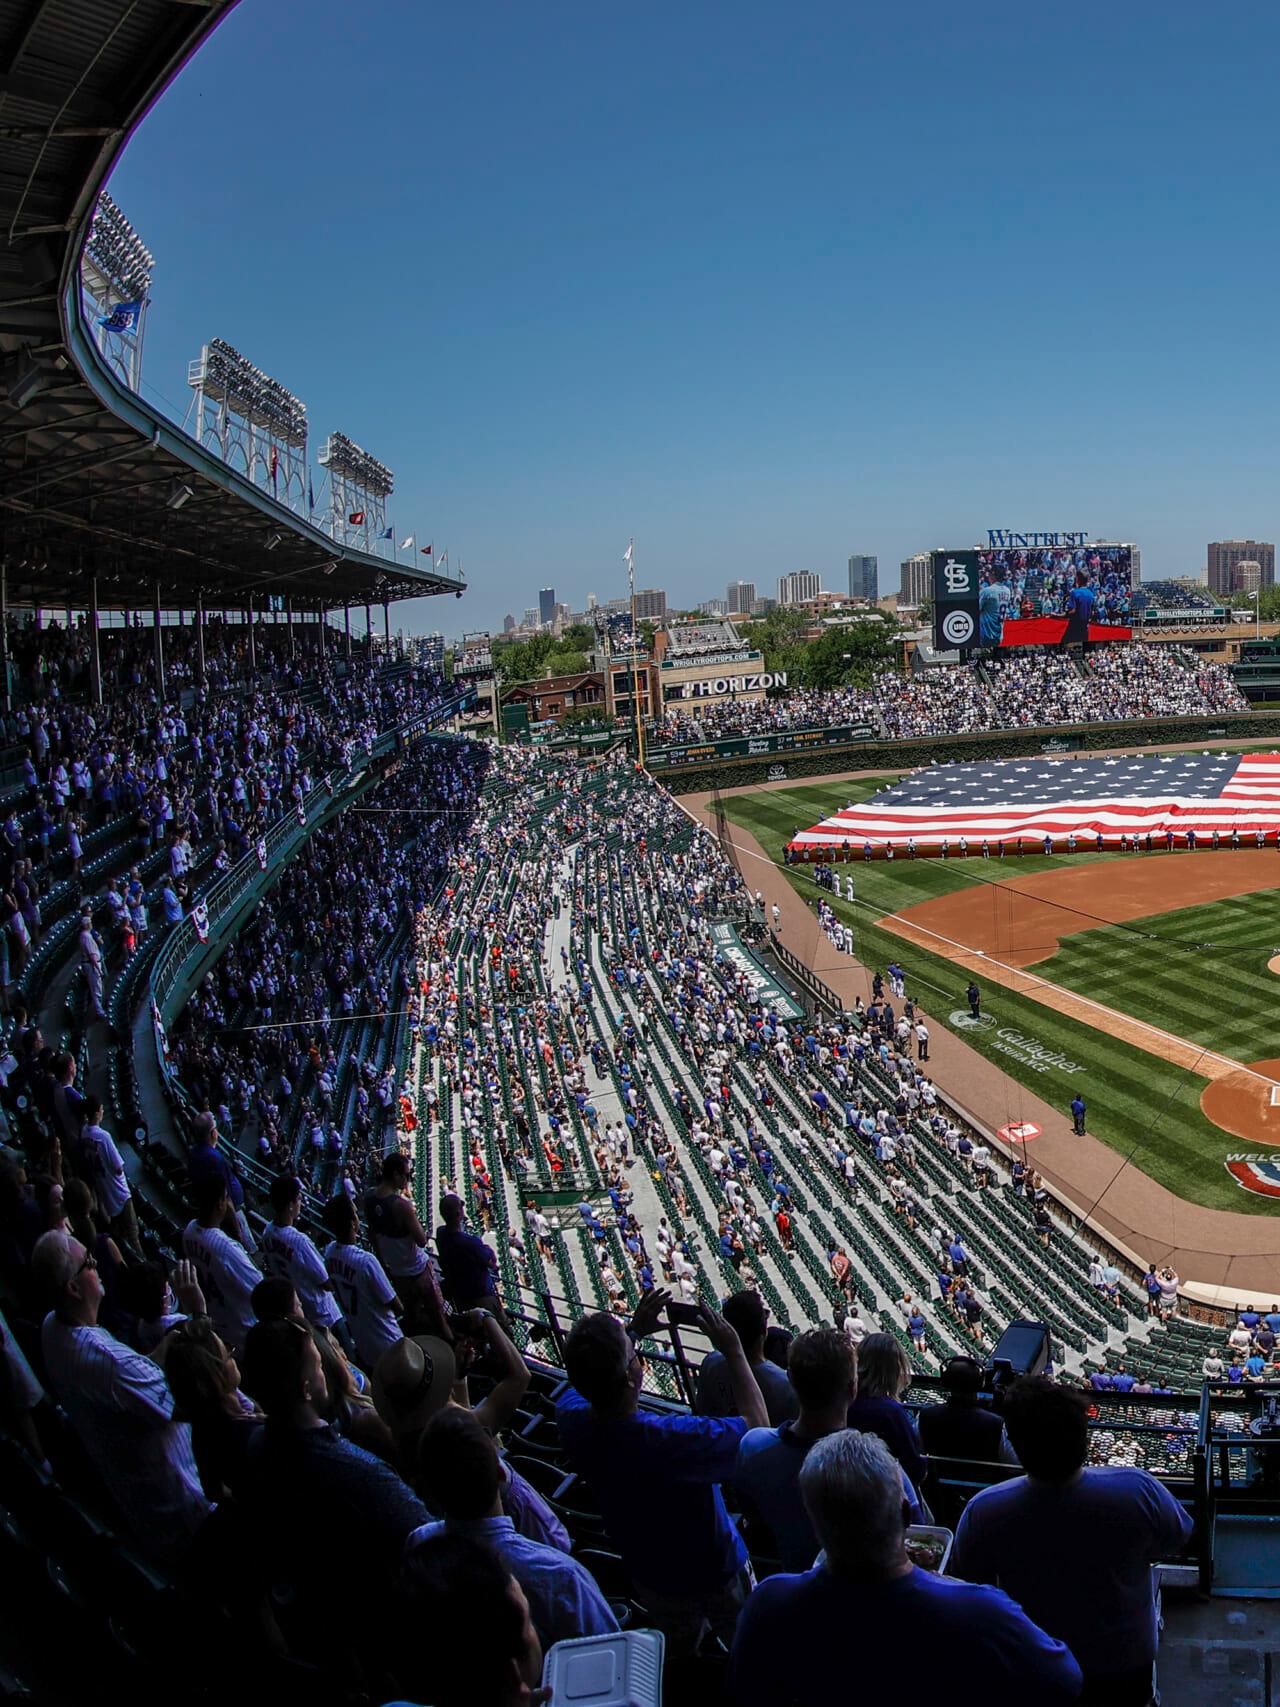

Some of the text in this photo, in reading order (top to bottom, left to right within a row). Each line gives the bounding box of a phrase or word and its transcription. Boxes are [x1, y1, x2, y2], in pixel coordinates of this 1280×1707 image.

[987, 529, 1088, 548] WINTRUST
[673, 652, 749, 667] WRIGLEYROOFTOPS.COM
[700, 672, 787, 696] HORIZON
[990, 1041, 1050, 1073] INSURANCE
[997, 1028, 1088, 1074] Gallagher
